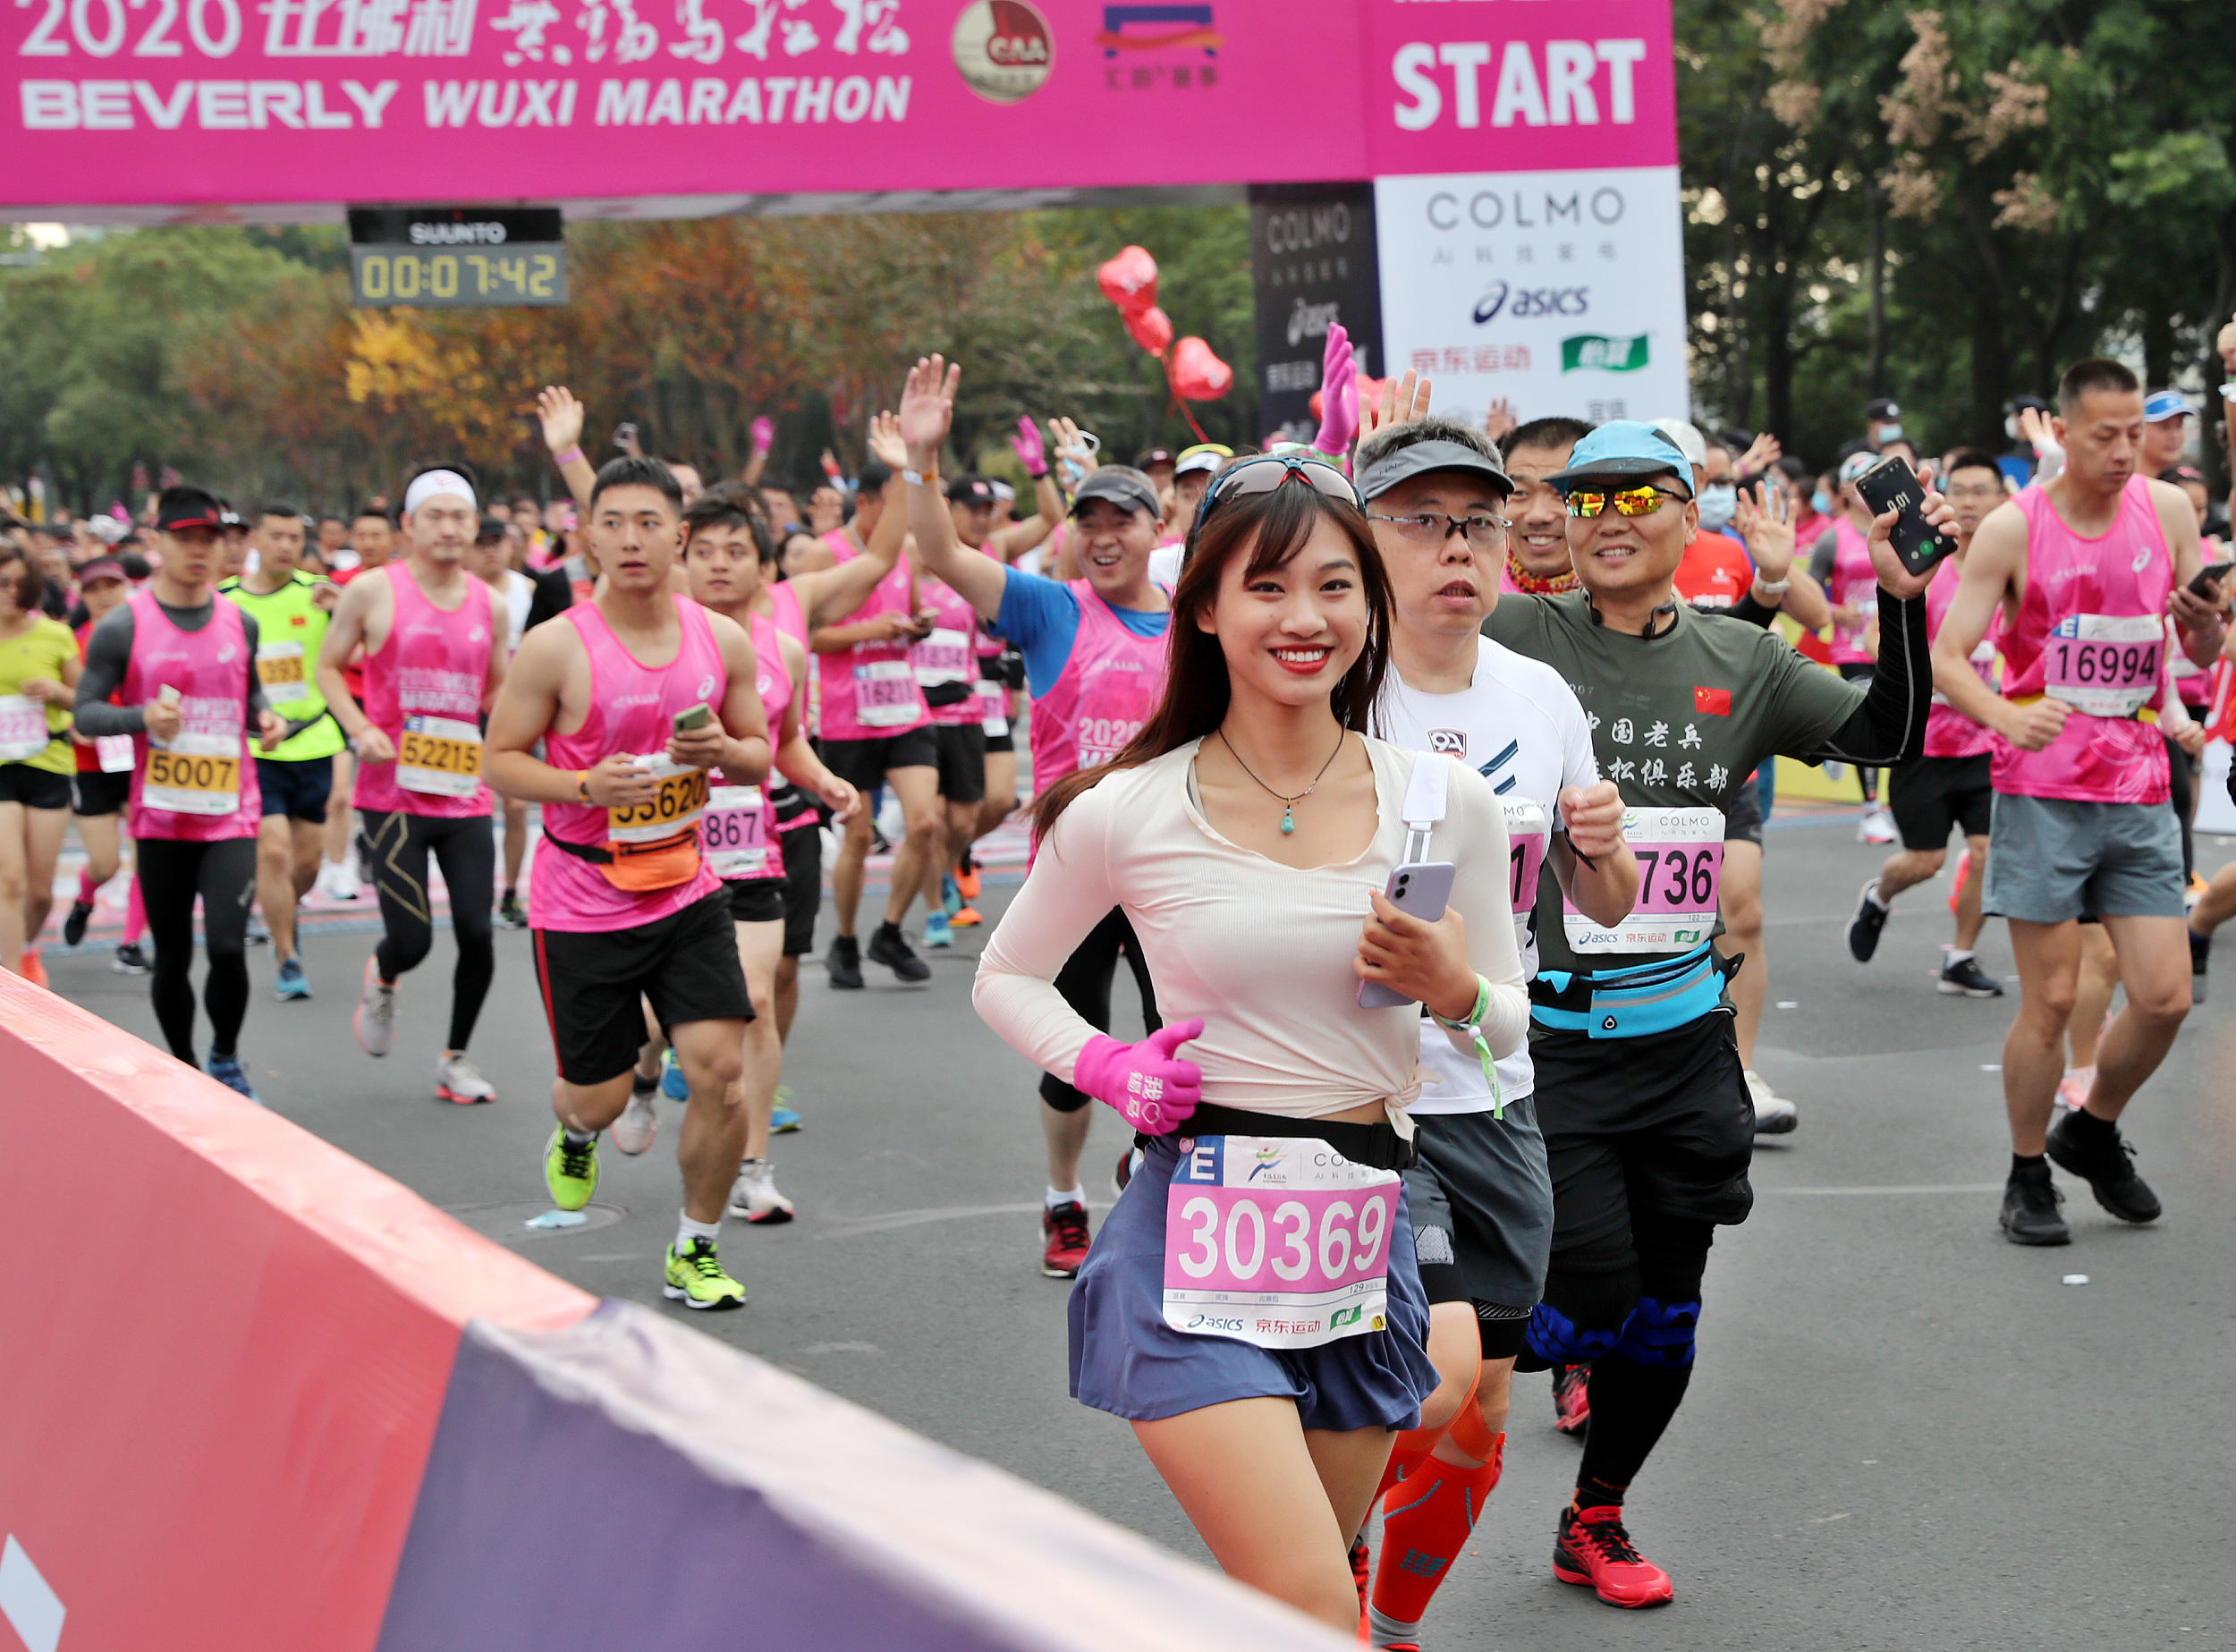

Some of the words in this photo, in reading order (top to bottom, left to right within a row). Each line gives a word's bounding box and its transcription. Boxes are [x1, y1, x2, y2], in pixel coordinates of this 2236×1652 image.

[14, 0, 242, 58] 2020
[1393, 38, 1647, 131] START
[20, 79, 401, 130] BEVERLY
[422, 79, 578, 128] WUXI
[595, 75, 912, 125] MARATHON
[1426, 186, 1626, 232] COLMO
[410, 221, 507, 244] SUUNTO
[362, 254, 556, 298] 00:07:42
[2058, 644, 2156, 683] 16994
[153, 754, 233, 788] 5007
[405, 737, 478, 772] 52215
[1659, 816, 1710, 826] COLMO
[1634, 850, 1714, 905] 736
[1591, 933, 1618, 944] asics
[1626, 933, 1667, 944] 京东运动
[1190, 1147, 1216, 1181] E
[1178, 1195, 1386, 1282] 30369
[1350, 1283, 1365, 1294] 129
[1206, 1317, 1244, 1332] asics
[1256, 1318, 1321, 1334] 京东运动
